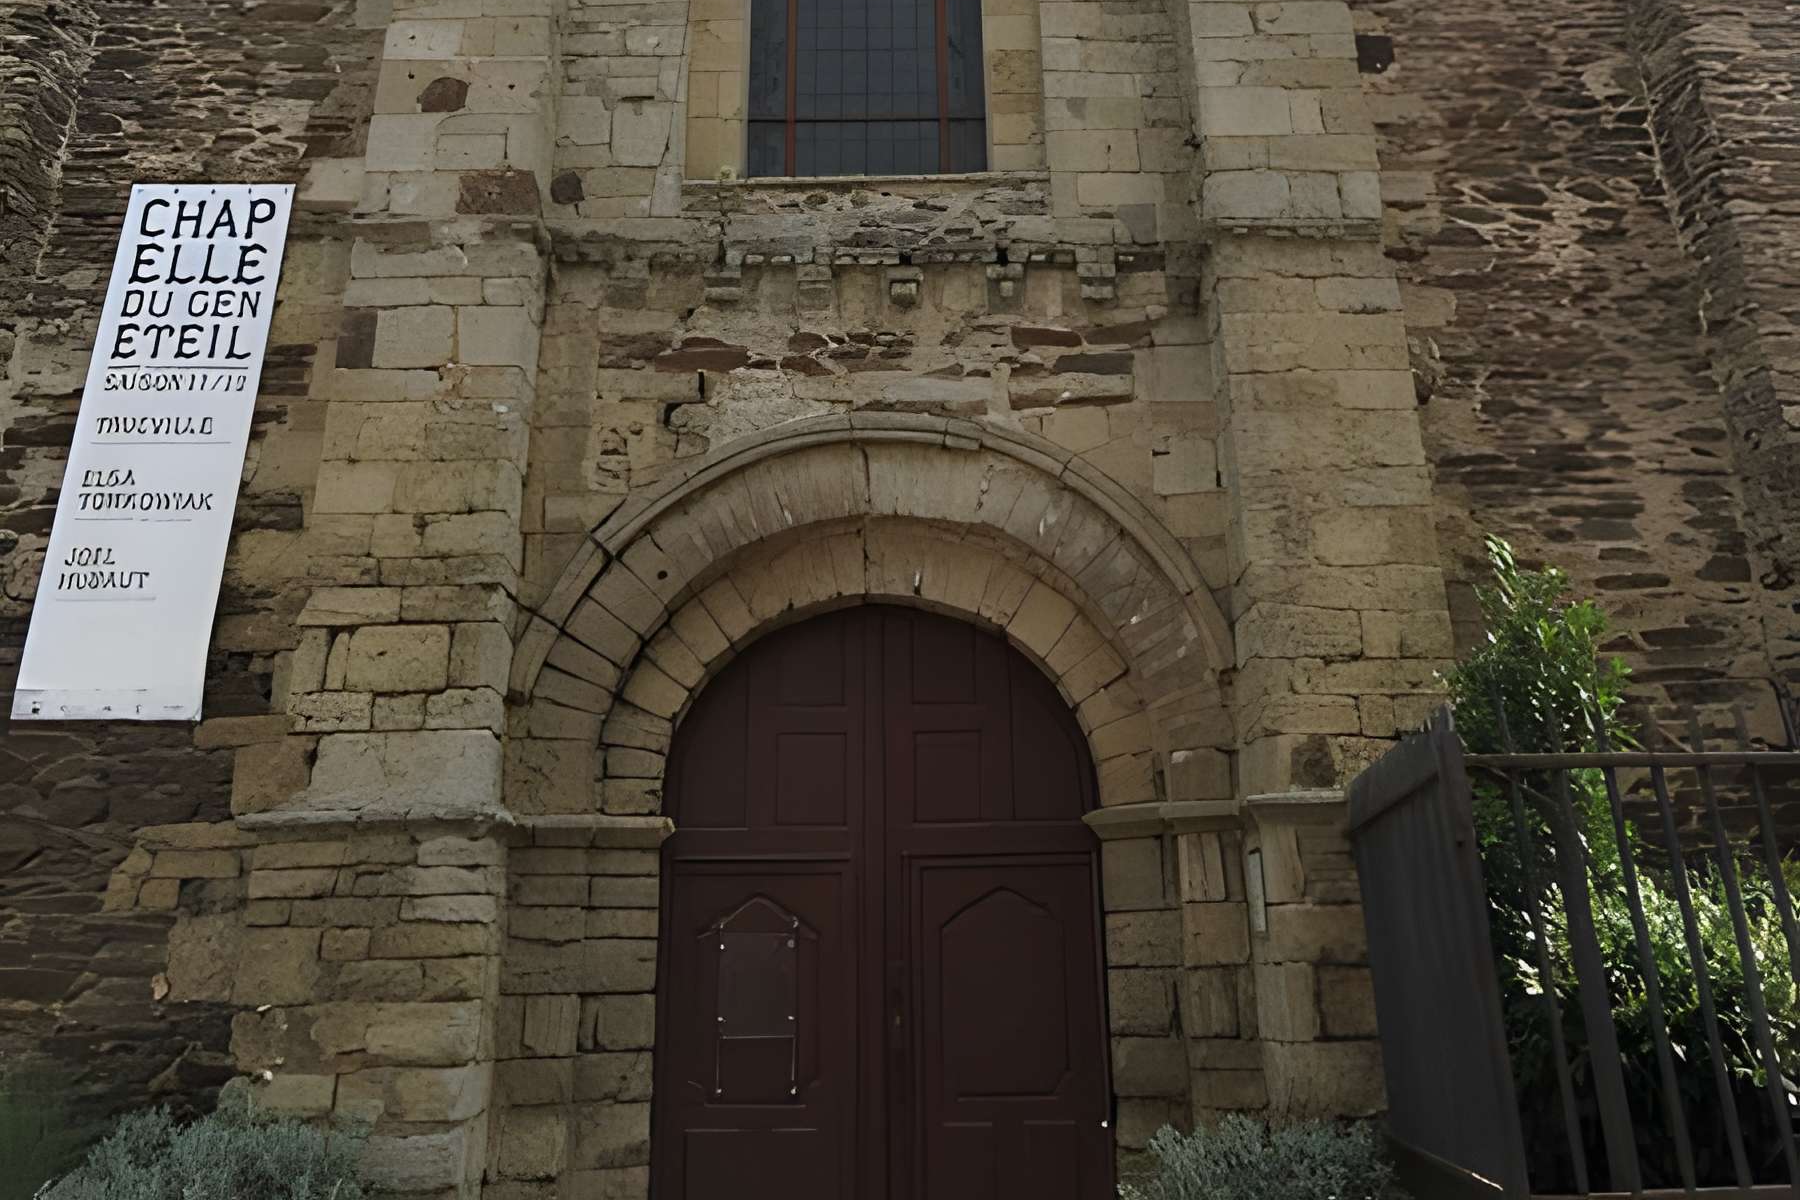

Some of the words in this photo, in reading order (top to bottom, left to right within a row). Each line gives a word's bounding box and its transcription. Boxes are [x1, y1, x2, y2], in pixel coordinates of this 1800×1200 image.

[140, 198, 276, 239] CHAP
[128, 243, 267, 284] ELLE
[121, 290, 173, 318] DU
[188, 290, 261, 318] GEN
[111, 323, 251, 359] ETEIL
